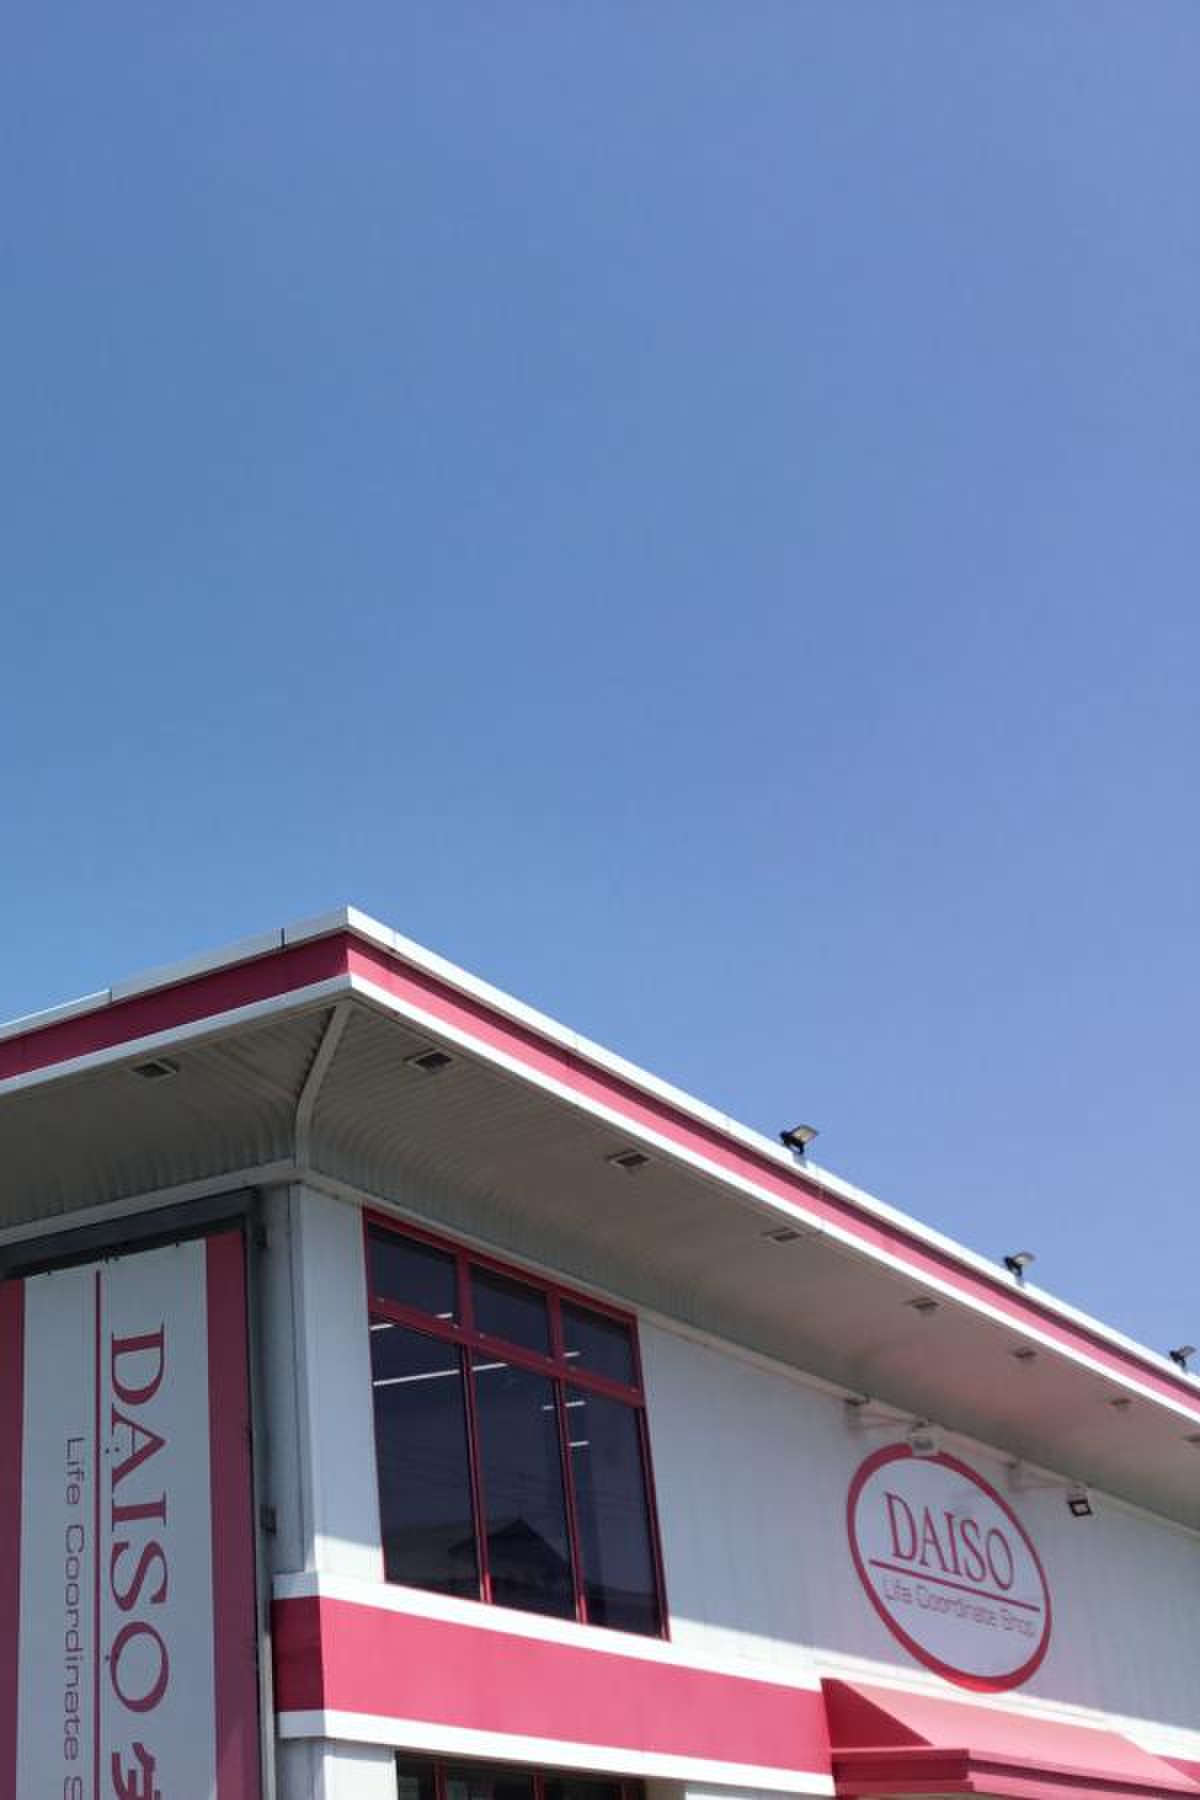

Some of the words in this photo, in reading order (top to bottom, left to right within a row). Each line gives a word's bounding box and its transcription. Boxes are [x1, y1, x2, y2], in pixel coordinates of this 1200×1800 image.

[63, 1437, 86, 1505] Life
[111, 1321, 170, 1713] DAISO
[884, 1491, 1014, 1592] DAISO
[63, 1524, 86, 1761] Coordinate
